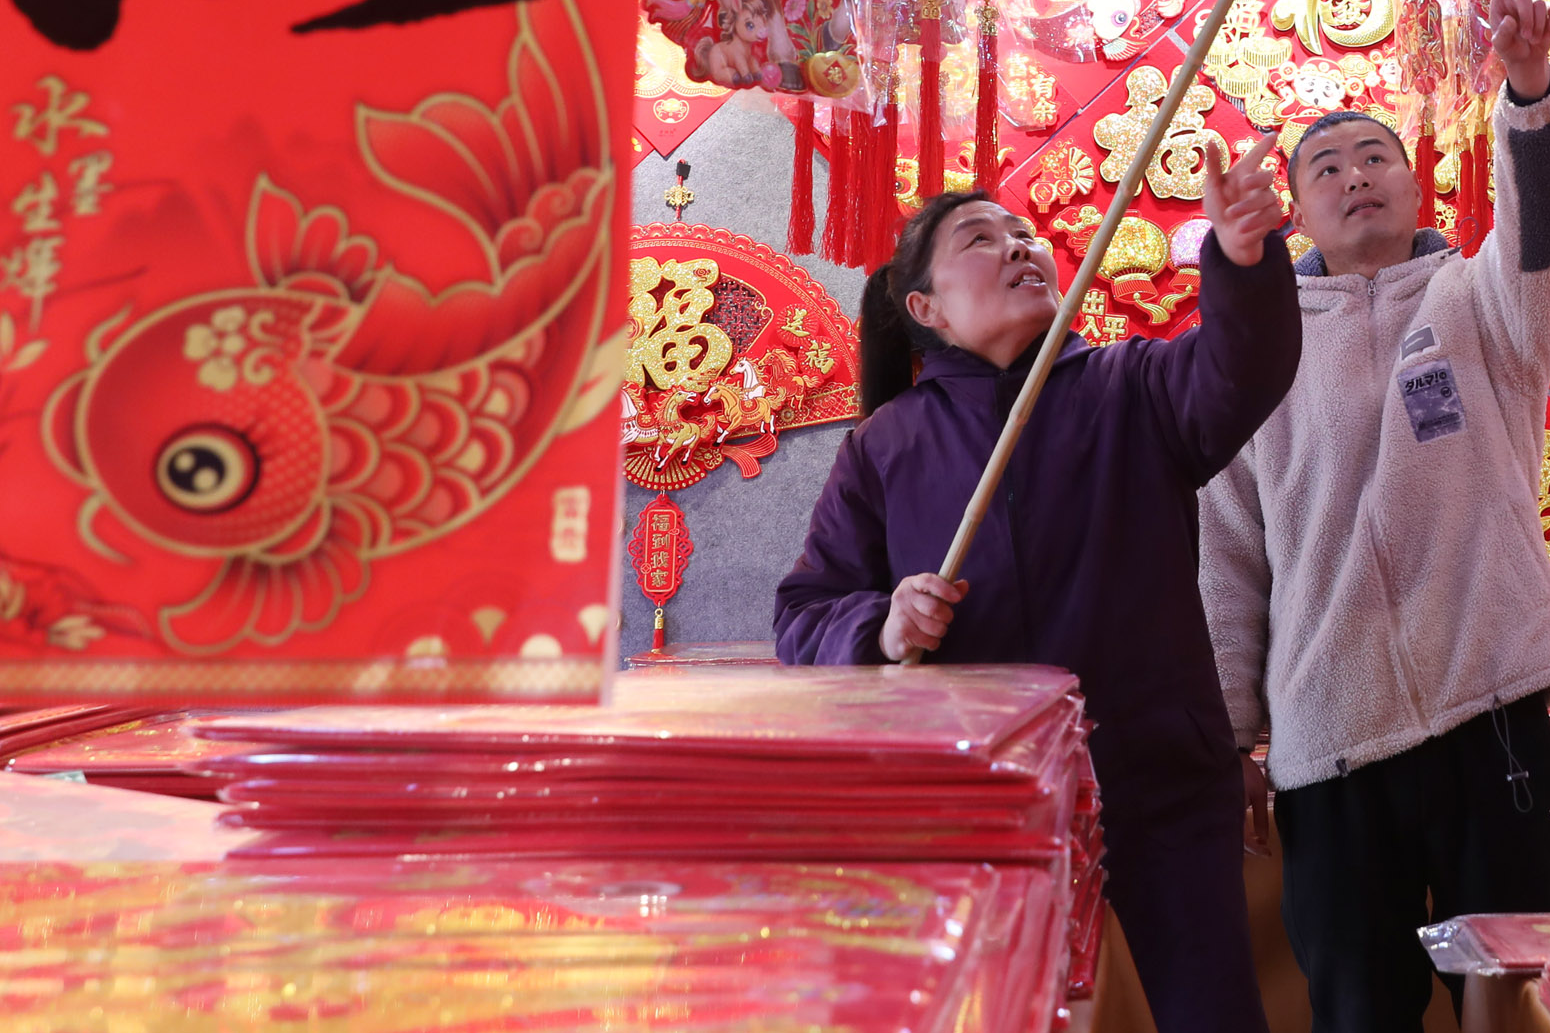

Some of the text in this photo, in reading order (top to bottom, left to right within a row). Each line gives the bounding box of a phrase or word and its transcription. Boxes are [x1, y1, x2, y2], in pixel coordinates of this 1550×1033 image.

[1030, 73, 1057, 122] 有余
[623, 256, 733, 393] 福
[650, 513, 671, 588] 福到我家
